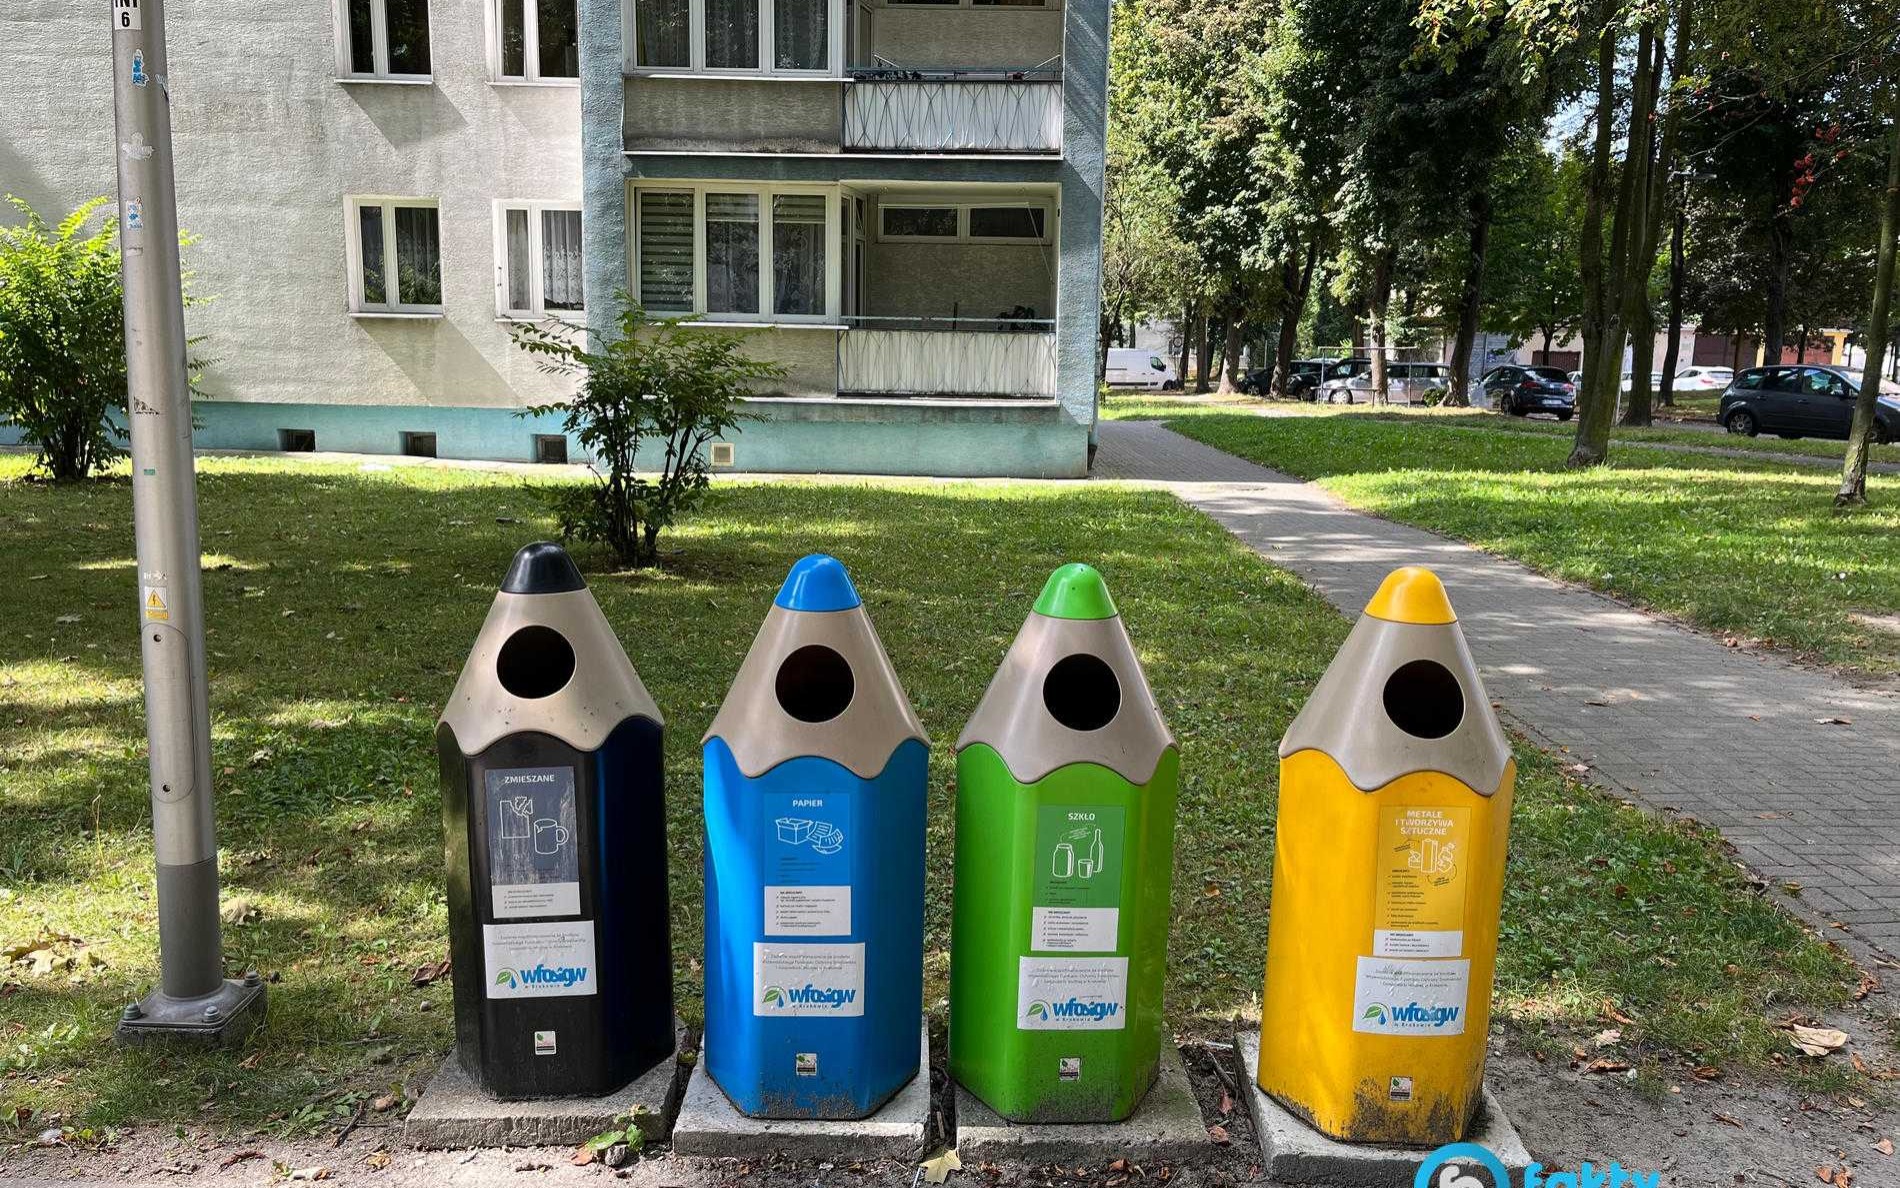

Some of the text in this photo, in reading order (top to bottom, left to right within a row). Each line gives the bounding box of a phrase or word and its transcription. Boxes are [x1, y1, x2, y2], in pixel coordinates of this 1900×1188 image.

[121, 11, 131, 28] 6
[504, 774, 555, 784] ZMIESZANE
[792, 799, 823, 807] PAPIER
[1067, 812, 1096, 821] SZKŁO
[1406, 810, 1443, 818] METALE
[1400, 818, 1454, 827] TWORZYWA
[1400, 827, 1447, 836] SZTUCZNE
